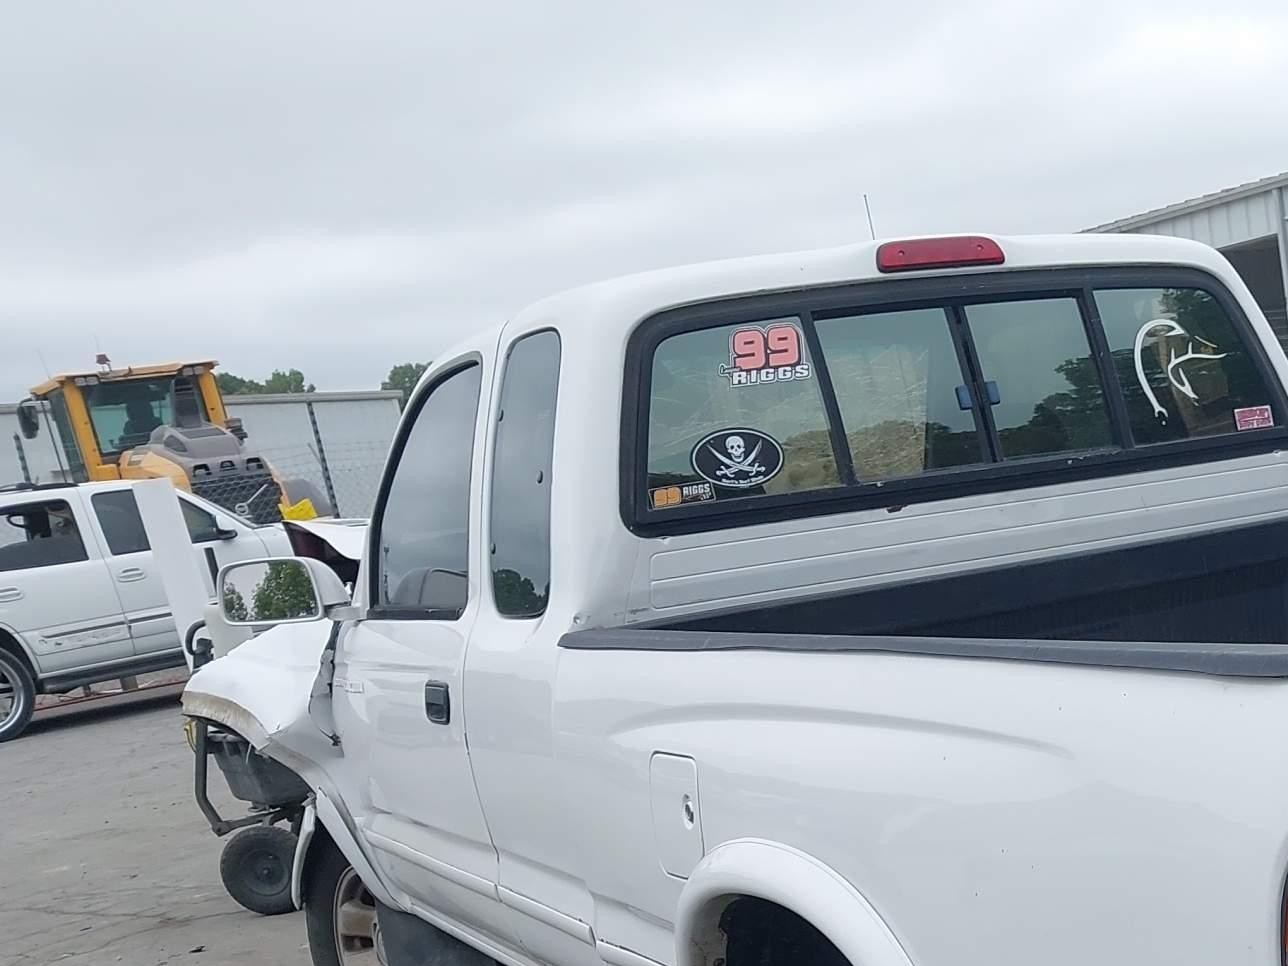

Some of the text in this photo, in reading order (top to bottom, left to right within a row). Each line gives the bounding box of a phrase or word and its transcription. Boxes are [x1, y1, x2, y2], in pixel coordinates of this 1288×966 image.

[733, 323, 801, 370] 99
[732, 364, 809, 385] RIGGS
[683, 483, 711, 496] RIGGS
